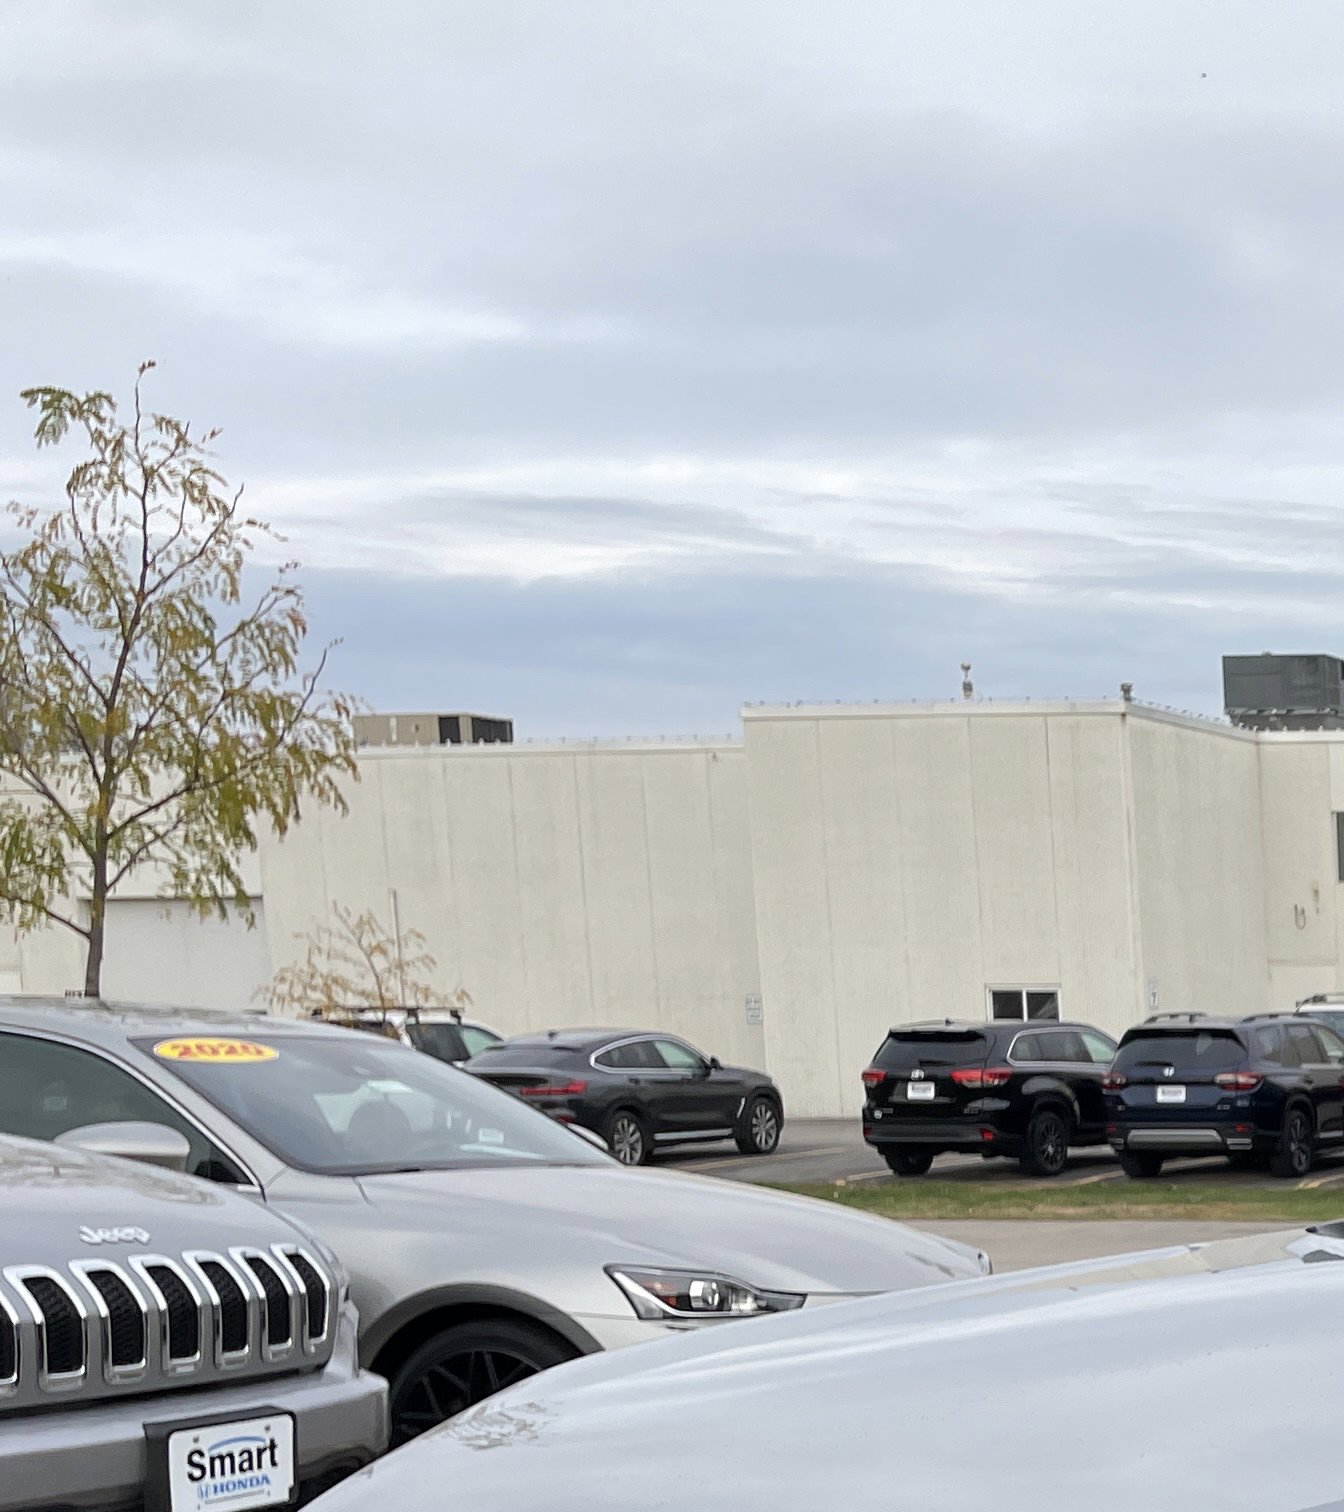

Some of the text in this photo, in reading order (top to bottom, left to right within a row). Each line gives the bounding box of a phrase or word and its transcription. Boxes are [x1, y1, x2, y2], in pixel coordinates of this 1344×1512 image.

[170, 1042, 265, 1058] 2020
[79, 1225, 151, 1245] Jeep
[187, 1437, 279, 1483] Smart
[213, 1472, 272, 1495] HONDA
